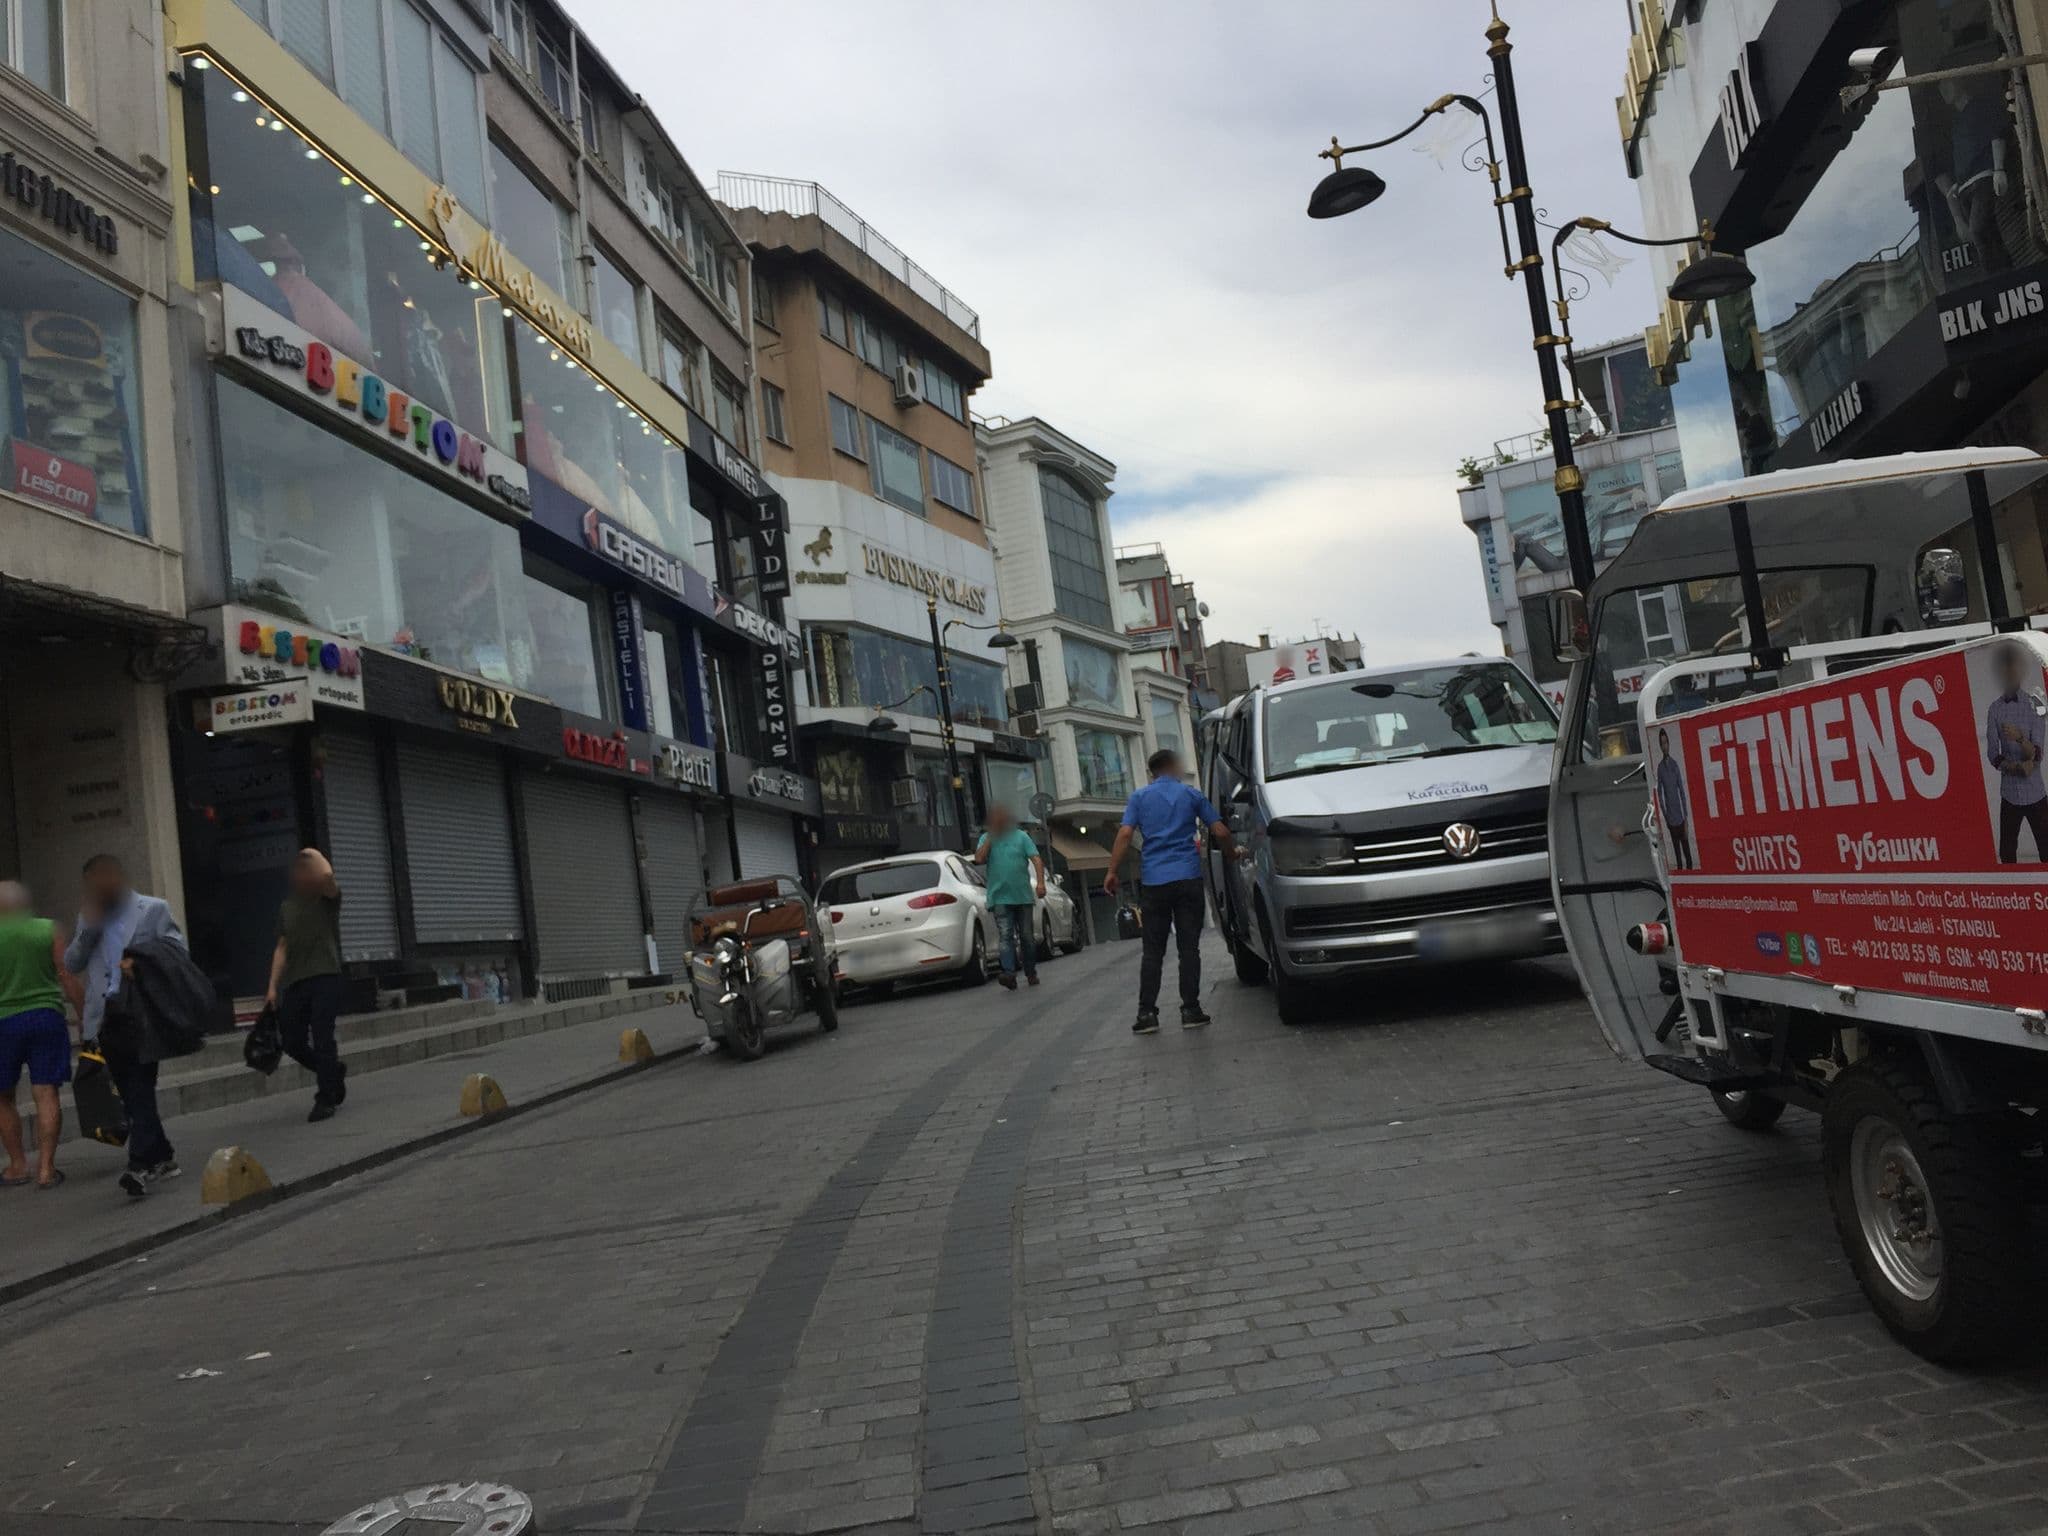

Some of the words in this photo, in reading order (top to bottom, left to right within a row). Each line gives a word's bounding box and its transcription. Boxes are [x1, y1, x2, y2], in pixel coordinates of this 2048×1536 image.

[1718, 43, 1761, 171] BLK
[1939, 300, 1988, 342] BLK
[1994, 281, 2044, 325] JNS
[306, 341, 486, 484] BEBETOM
[712, 434, 759, 498] WANTED
[21, 467, 89, 507] Lescon
[862, 542, 940, 599] BUSINESS
[941, 574, 986, 616] CLASS
[239, 620, 361, 679] BEBETOM
[215, 693, 298, 716] BEBETOM
[1698, 677, 1950, 819] FiTMENS
[1732, 834, 1801, 872] SHIRTS
[1837, 832, 1940, 870] Рубашки
[1812, 889, 1839, 905] Mimar
[1840, 889, 1889, 906] Kemalettin
[1891, 890, 1915, 907] Mah.
[1916, 891, 1943, 908] Ordu
[1945, 891, 1970, 908] Cad.
[1972, 892, 2031, 910] Hazinedar
[1907, 916, 1935, 935] Laleli
[1941, 914, 2000, 938] İSTANBUL
[1825, 937, 1848, 956] TEL:
[1852, 940, 1869, 958] +90
[1871, 941, 1890, 959] 212
[1891, 942, 1911, 961] 638
[1913, 944, 1926, 963] 55
[1927, 944, 1941, 964] 96
[1946, 946, 1975, 968] GSM:
[1977, 949, 1999, 970] +90
[2002, 950, 2025, 973] 538
[1902, 969, 1990, 993] www.fitmens.net
